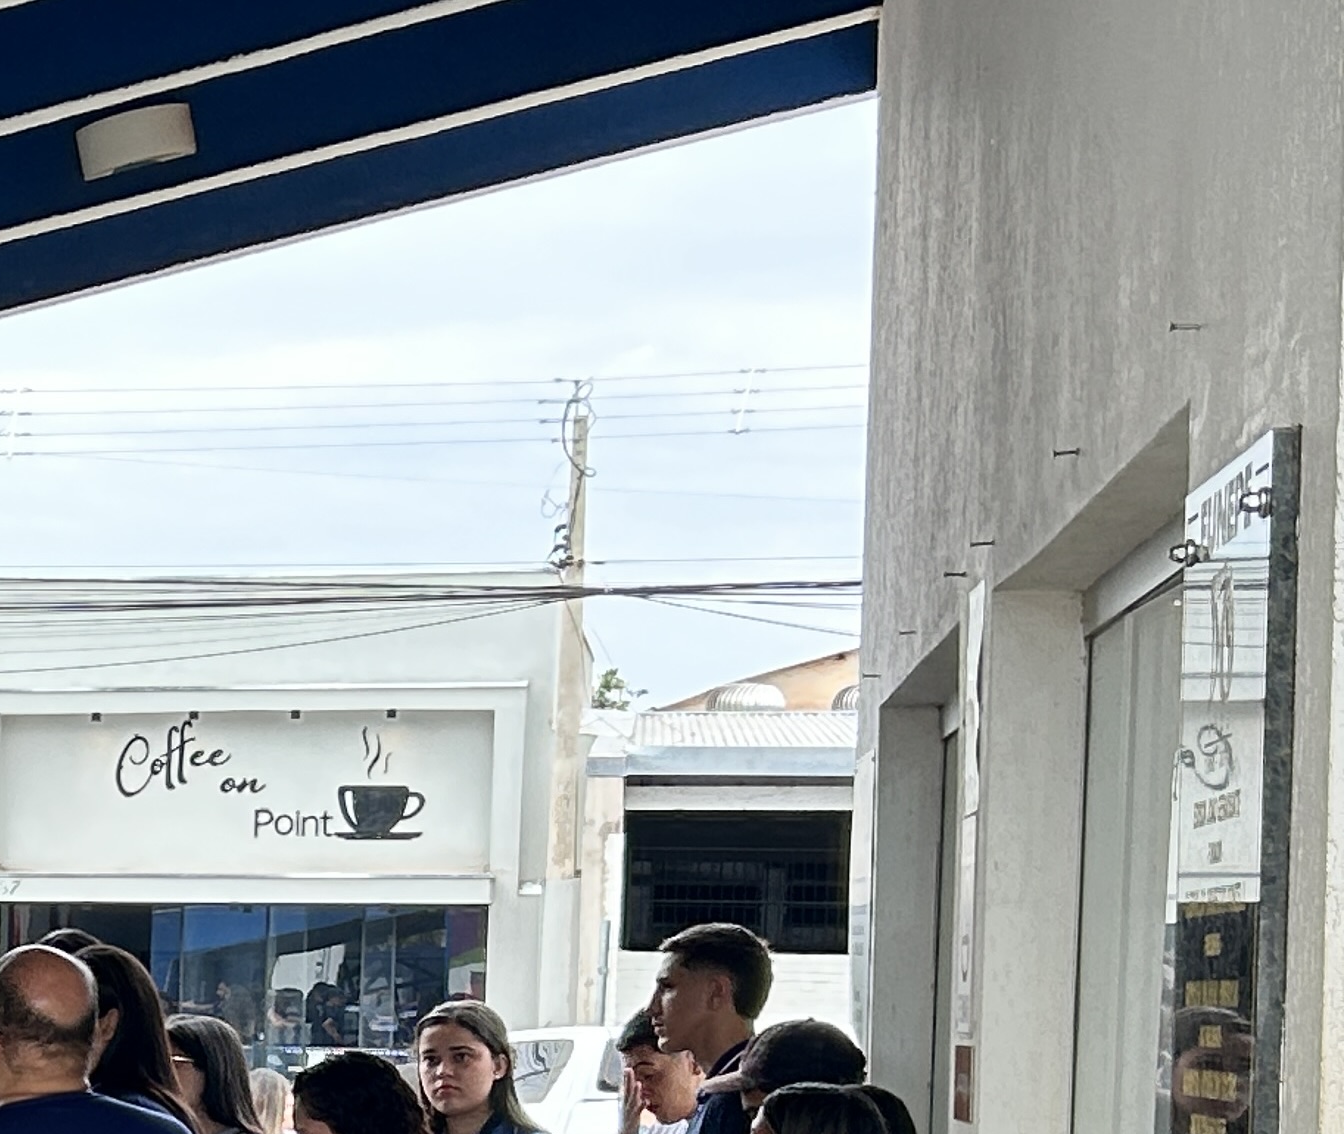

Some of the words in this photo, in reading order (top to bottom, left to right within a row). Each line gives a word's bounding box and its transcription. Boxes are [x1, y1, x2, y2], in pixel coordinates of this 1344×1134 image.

[115, 720, 232, 798] Coffee
[220, 776, 267, 794] on
[253, 808, 334, 838] Point
